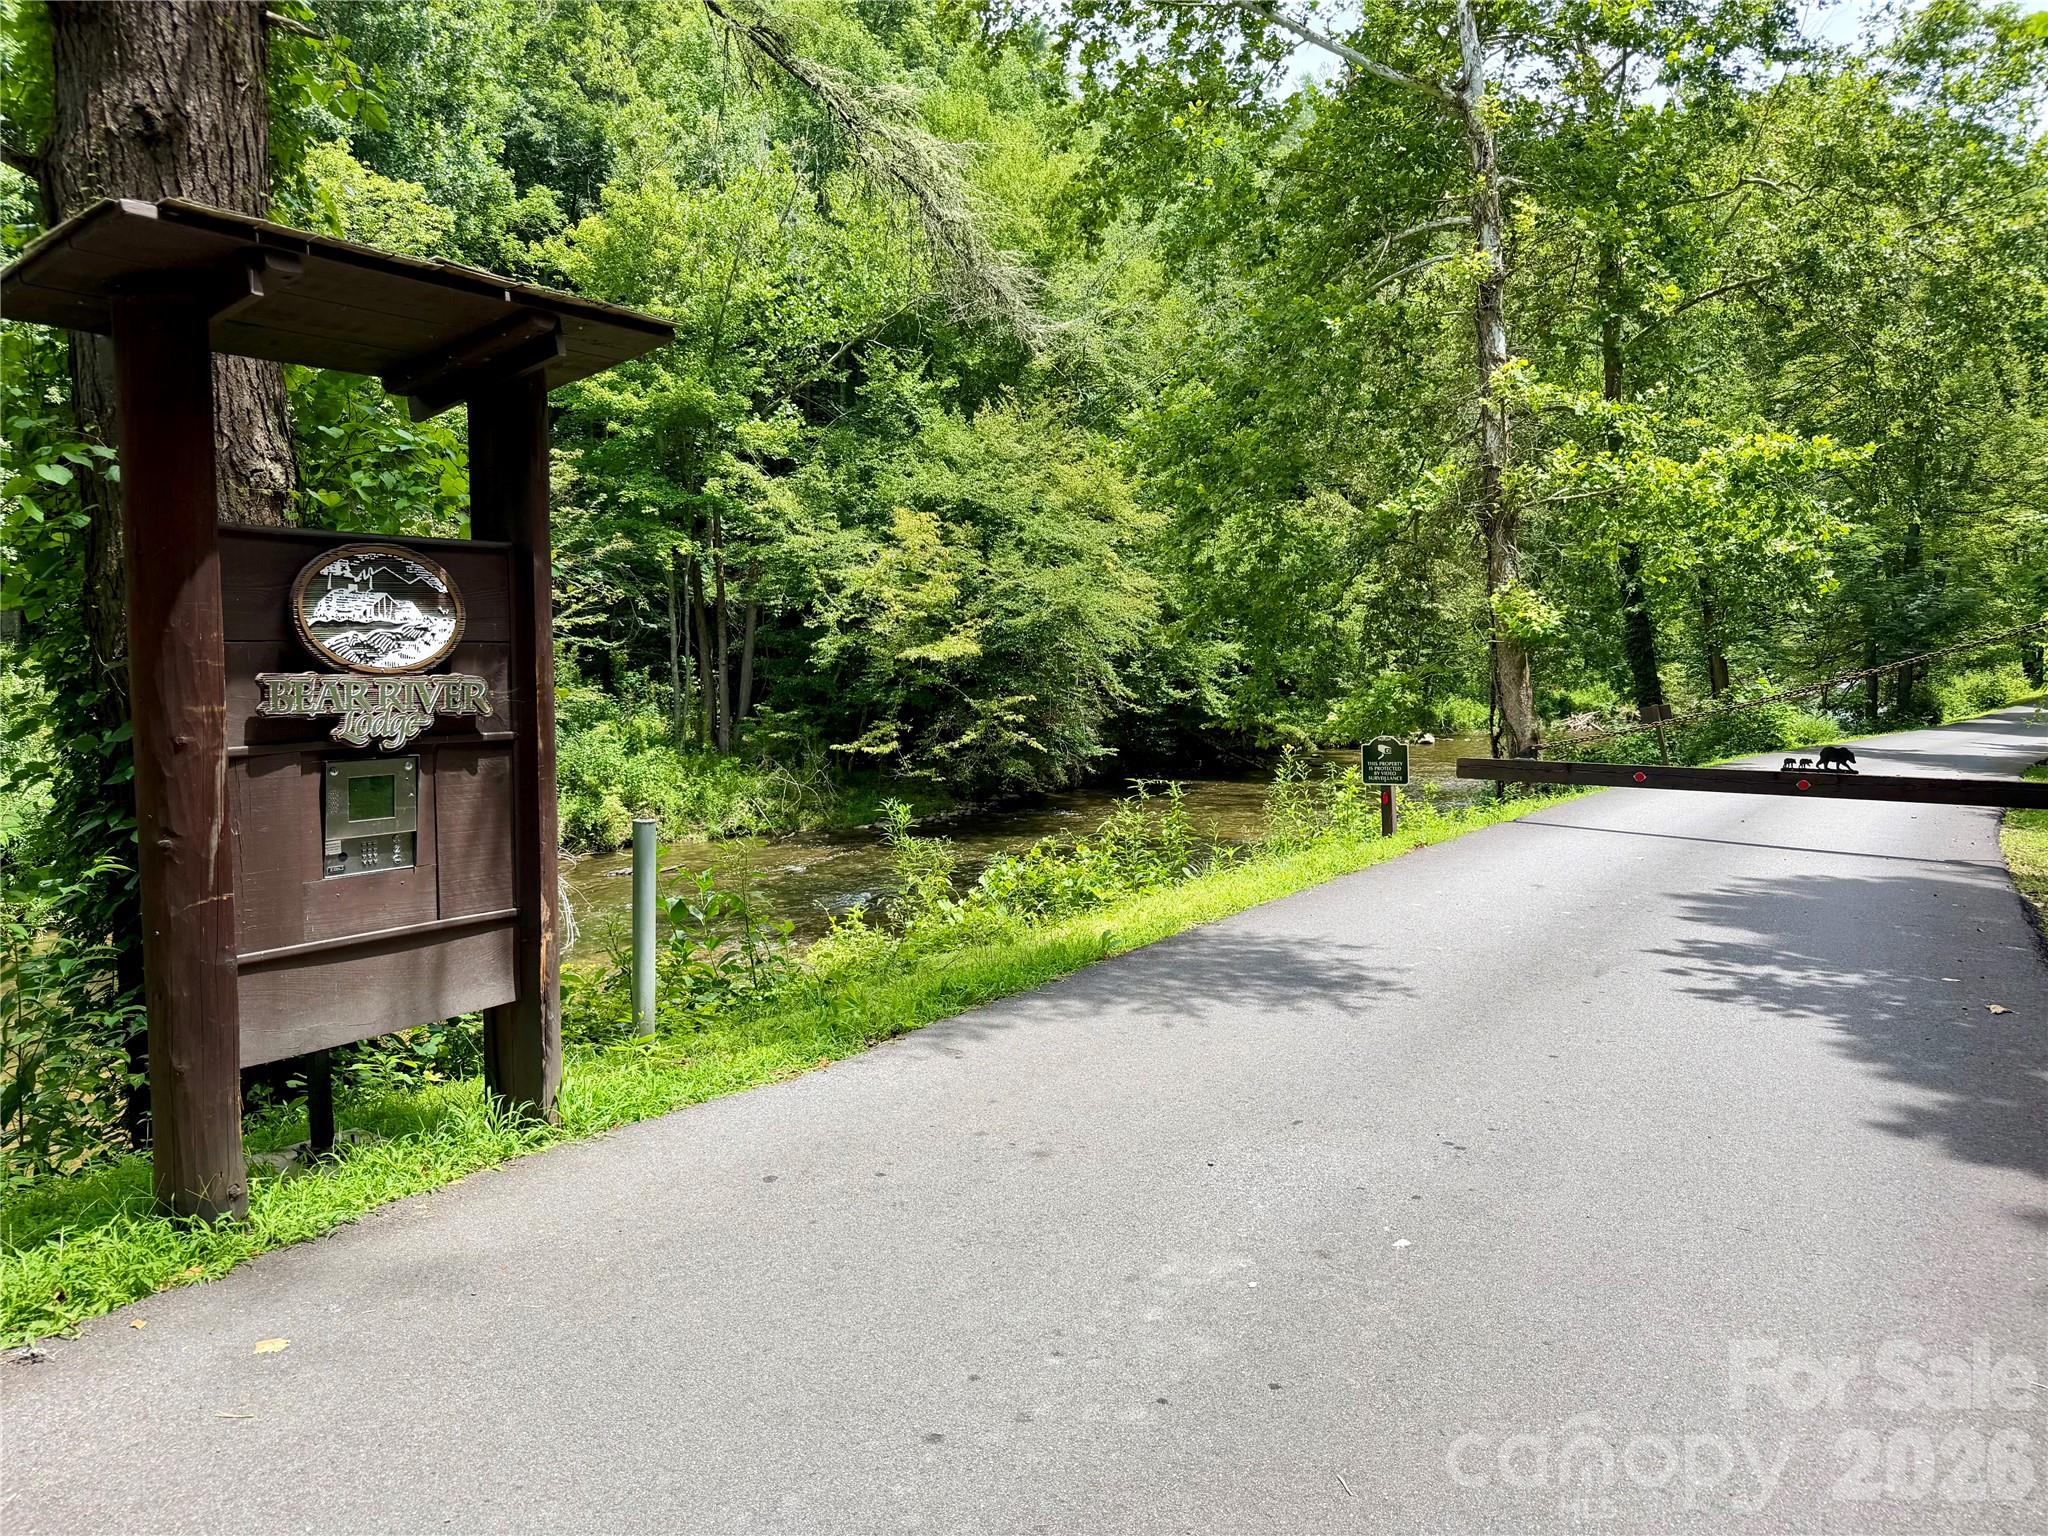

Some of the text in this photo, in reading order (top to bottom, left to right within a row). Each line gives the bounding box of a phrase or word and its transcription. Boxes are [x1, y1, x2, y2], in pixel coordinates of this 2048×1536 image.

[266, 678, 492, 715] BEAR RIVER
[333, 706, 433, 750] Lodge
